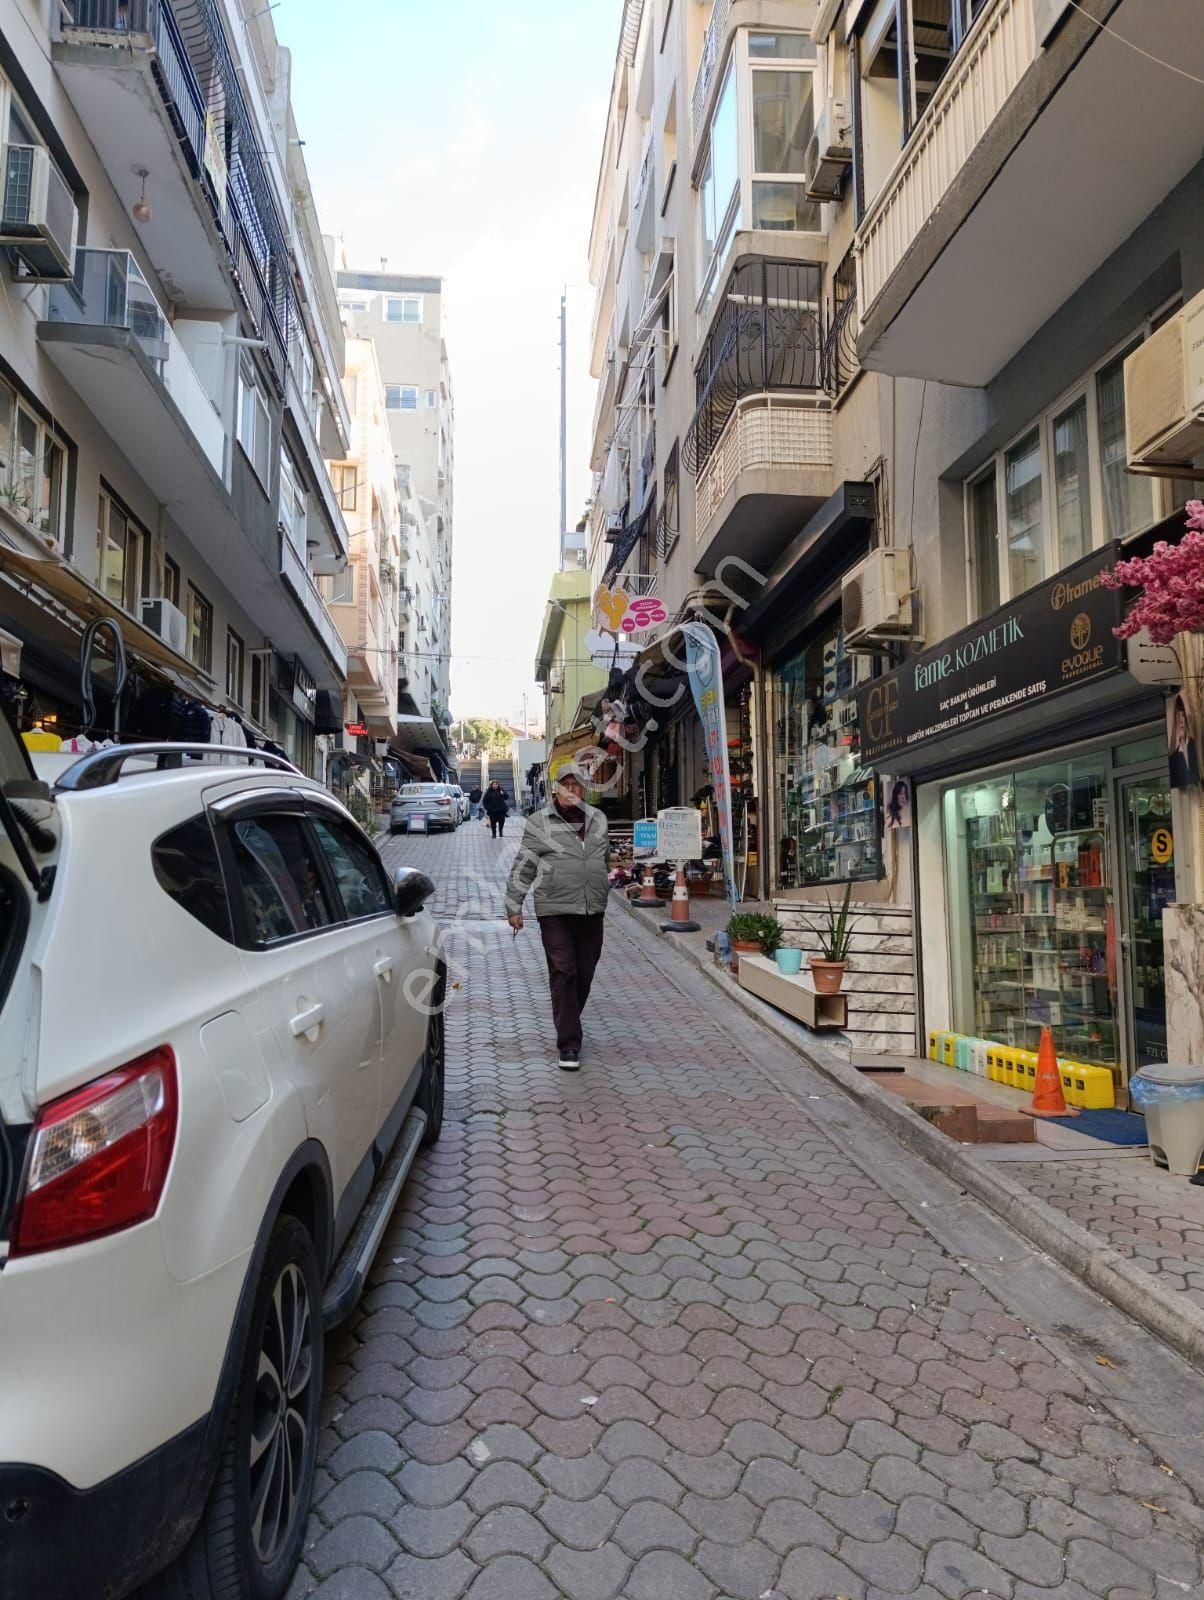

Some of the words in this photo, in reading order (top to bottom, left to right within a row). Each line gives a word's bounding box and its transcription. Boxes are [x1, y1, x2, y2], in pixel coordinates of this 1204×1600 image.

[914, 658, 954, 692] fame
[955, 614, 1025, 672] KOZMETİK
[1061, 643, 1104, 674] evoque
[939, 700, 950, 711] SAÇ
[950, 691, 968, 707] BAKIM
[967, 675, 997, 699] ÜRÜNLERİ
[906, 729, 925, 743] KUAFÖR
[925, 714, 959, 737] MALZEMELERİ
[959, 706, 980, 723] TOPTAN
[980, 702, 989, 714] VE
[989, 688, 1027, 713] PERAKENDE
[1027, 680, 1047, 696] SATIŞ
[1156, 832, 1168, 853] S
